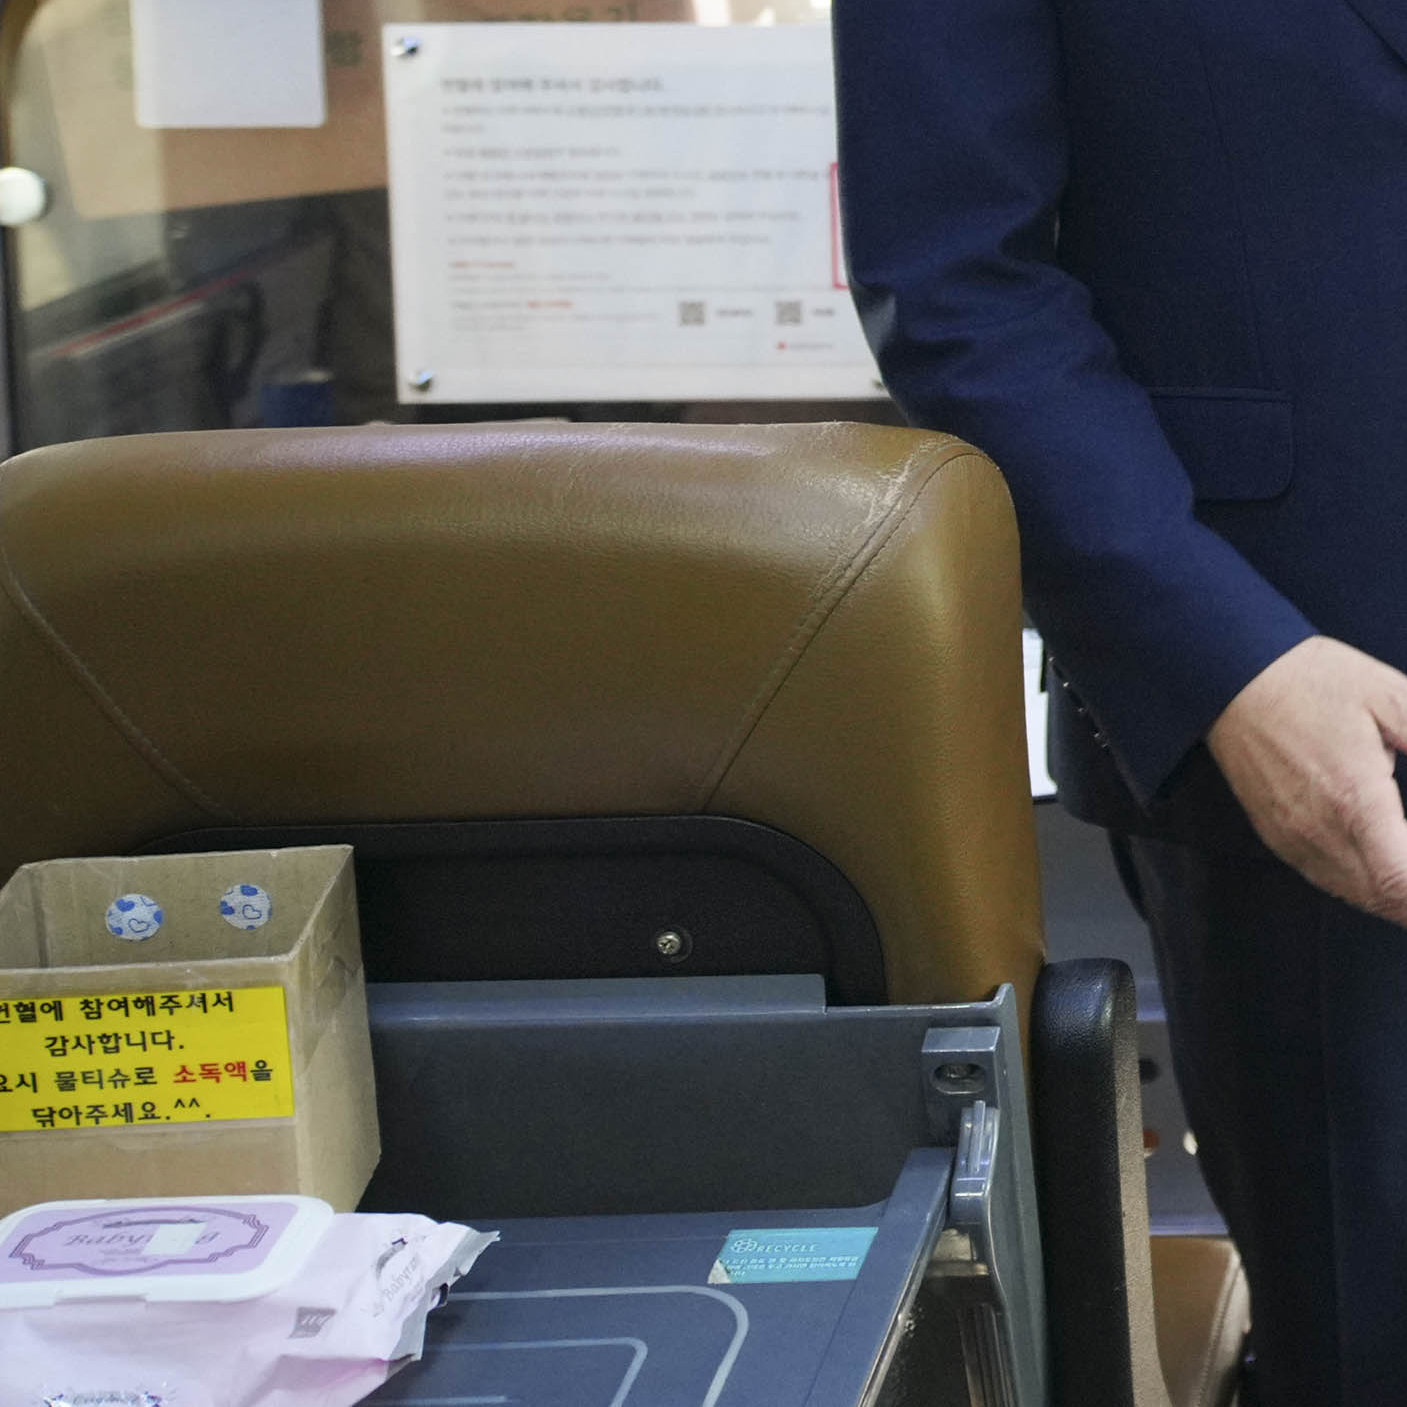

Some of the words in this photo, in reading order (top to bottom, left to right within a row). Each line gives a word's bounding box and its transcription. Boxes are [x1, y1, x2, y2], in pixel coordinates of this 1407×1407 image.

[79, 991, 235, 1020] 참여해주셔서
[44, 1029, 185, 1058] 감사합니다.
[54, 1065, 157, 1092] 물티슈로
[172, 1059, 273, 1084] 소독액을
[756, 1243, 817, 1253] RECYCLE
